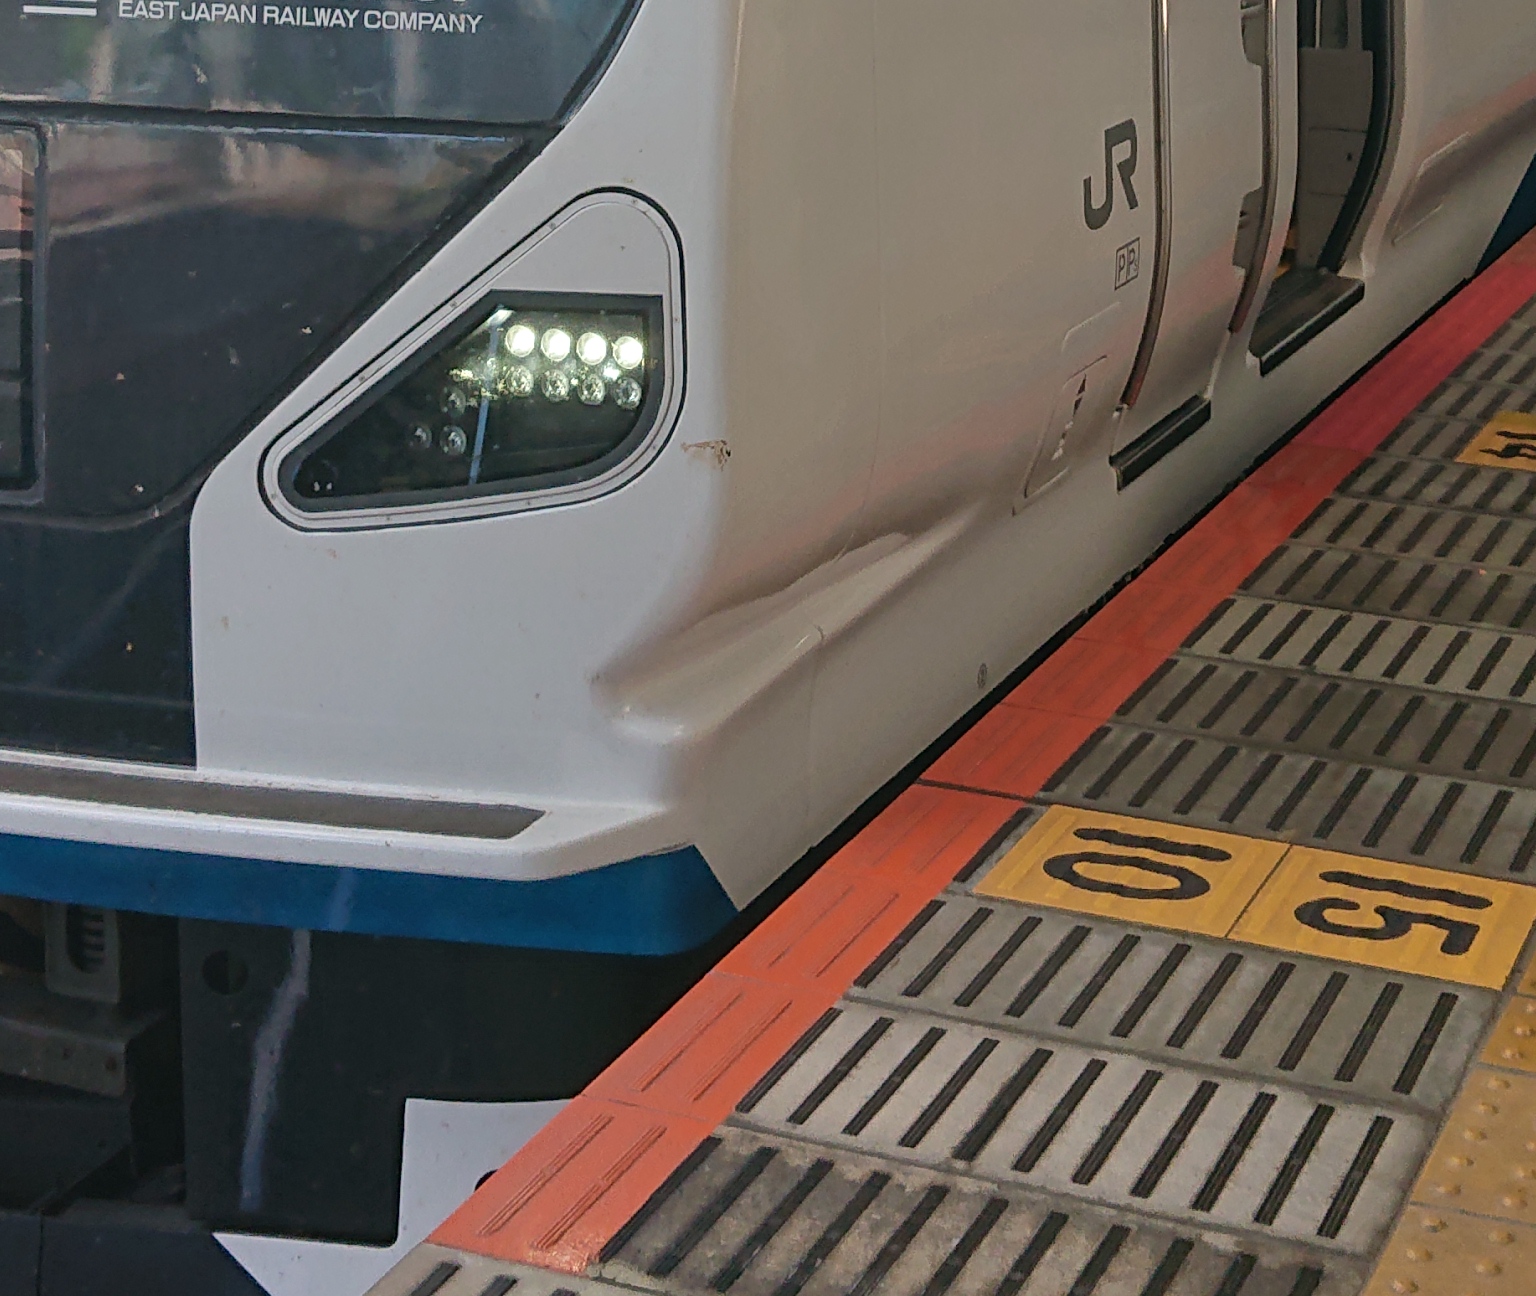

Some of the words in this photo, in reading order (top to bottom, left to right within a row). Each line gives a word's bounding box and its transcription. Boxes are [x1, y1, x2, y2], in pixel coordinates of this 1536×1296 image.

[118, 0, 179, 21] EAST
[181, 2, 257, 24] JAPAN
[262, 5, 358, 29] RAILWAY
[363, 9, 483, 35] COMPANY
[1083, 118, 1139, 230] JR
[1042, 827, 1233, 901] 10
[1293, 870, 1493, 956] 15
